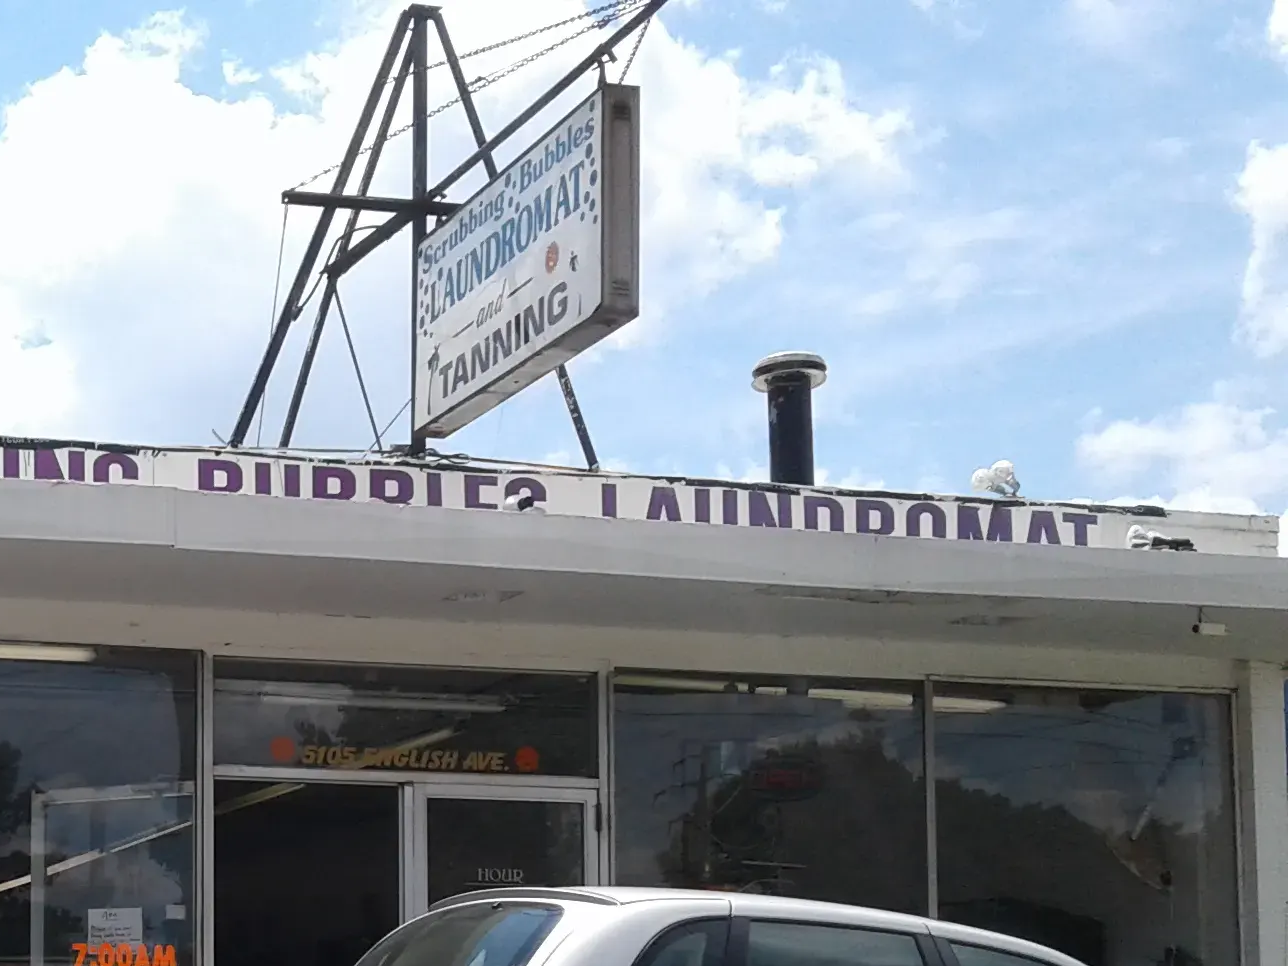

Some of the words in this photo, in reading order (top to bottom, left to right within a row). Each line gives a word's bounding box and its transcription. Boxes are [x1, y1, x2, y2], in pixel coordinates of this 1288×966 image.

[422, 193, 505, 274] Scrubbing
[518, 116, 595, 194] Bubbles
[430, 160, 585, 324] LAUNDROMAT
[439, 281, 568, 399] TANNING
[475, 278, 507, 329] and
[360, 747, 460, 770] ENGLISH
[462, 751, 511, 771] AVE.
